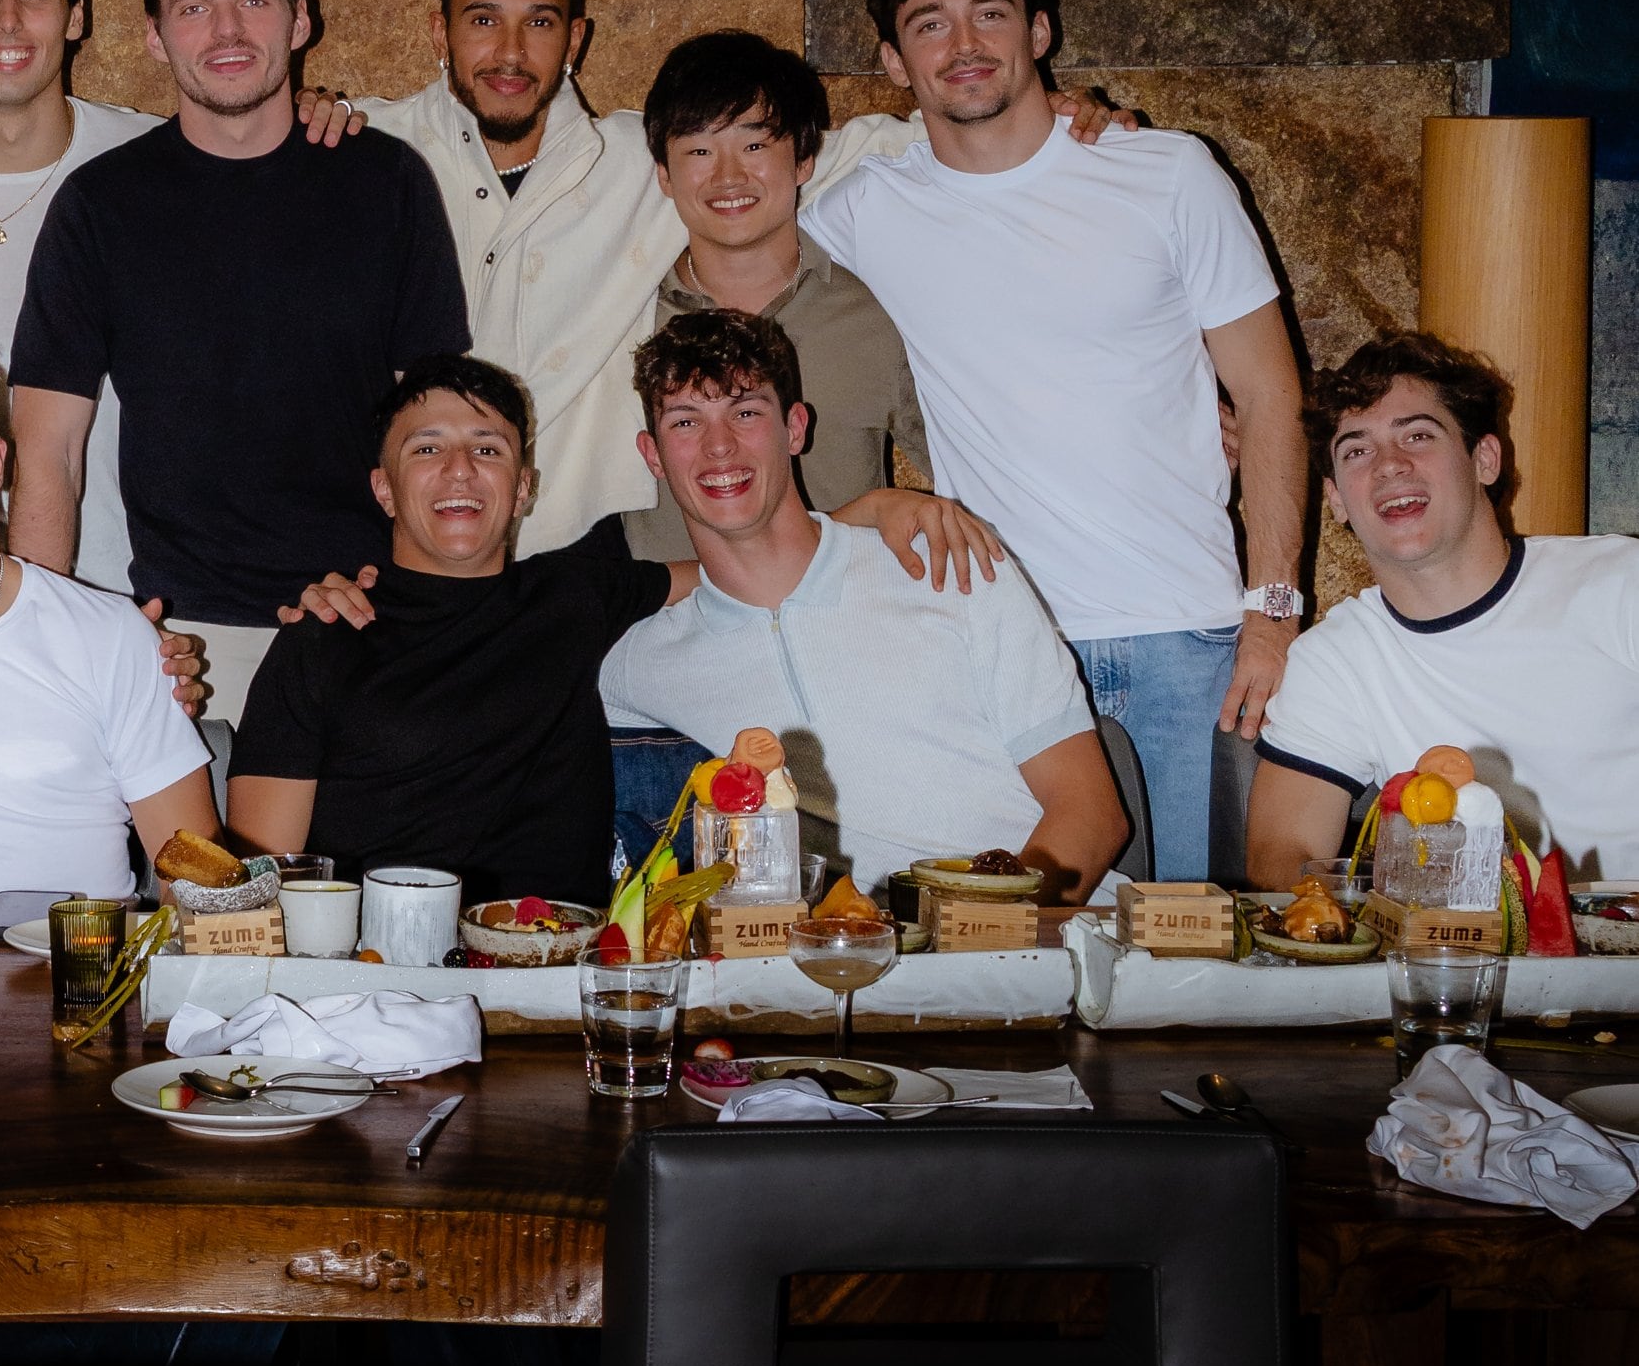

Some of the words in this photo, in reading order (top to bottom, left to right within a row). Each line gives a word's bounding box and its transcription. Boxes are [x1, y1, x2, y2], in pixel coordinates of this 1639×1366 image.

[1153, 913, 1211, 929] zuma
[1374, 911, 1399, 936] zuma
[208, 926, 265, 945] zuma
[1427, 926, 1482, 941] zuma
[212, 945, 232, 955] Hand
[234, 944, 260, 953] Crafted
[738, 939, 759, 948] Hand
